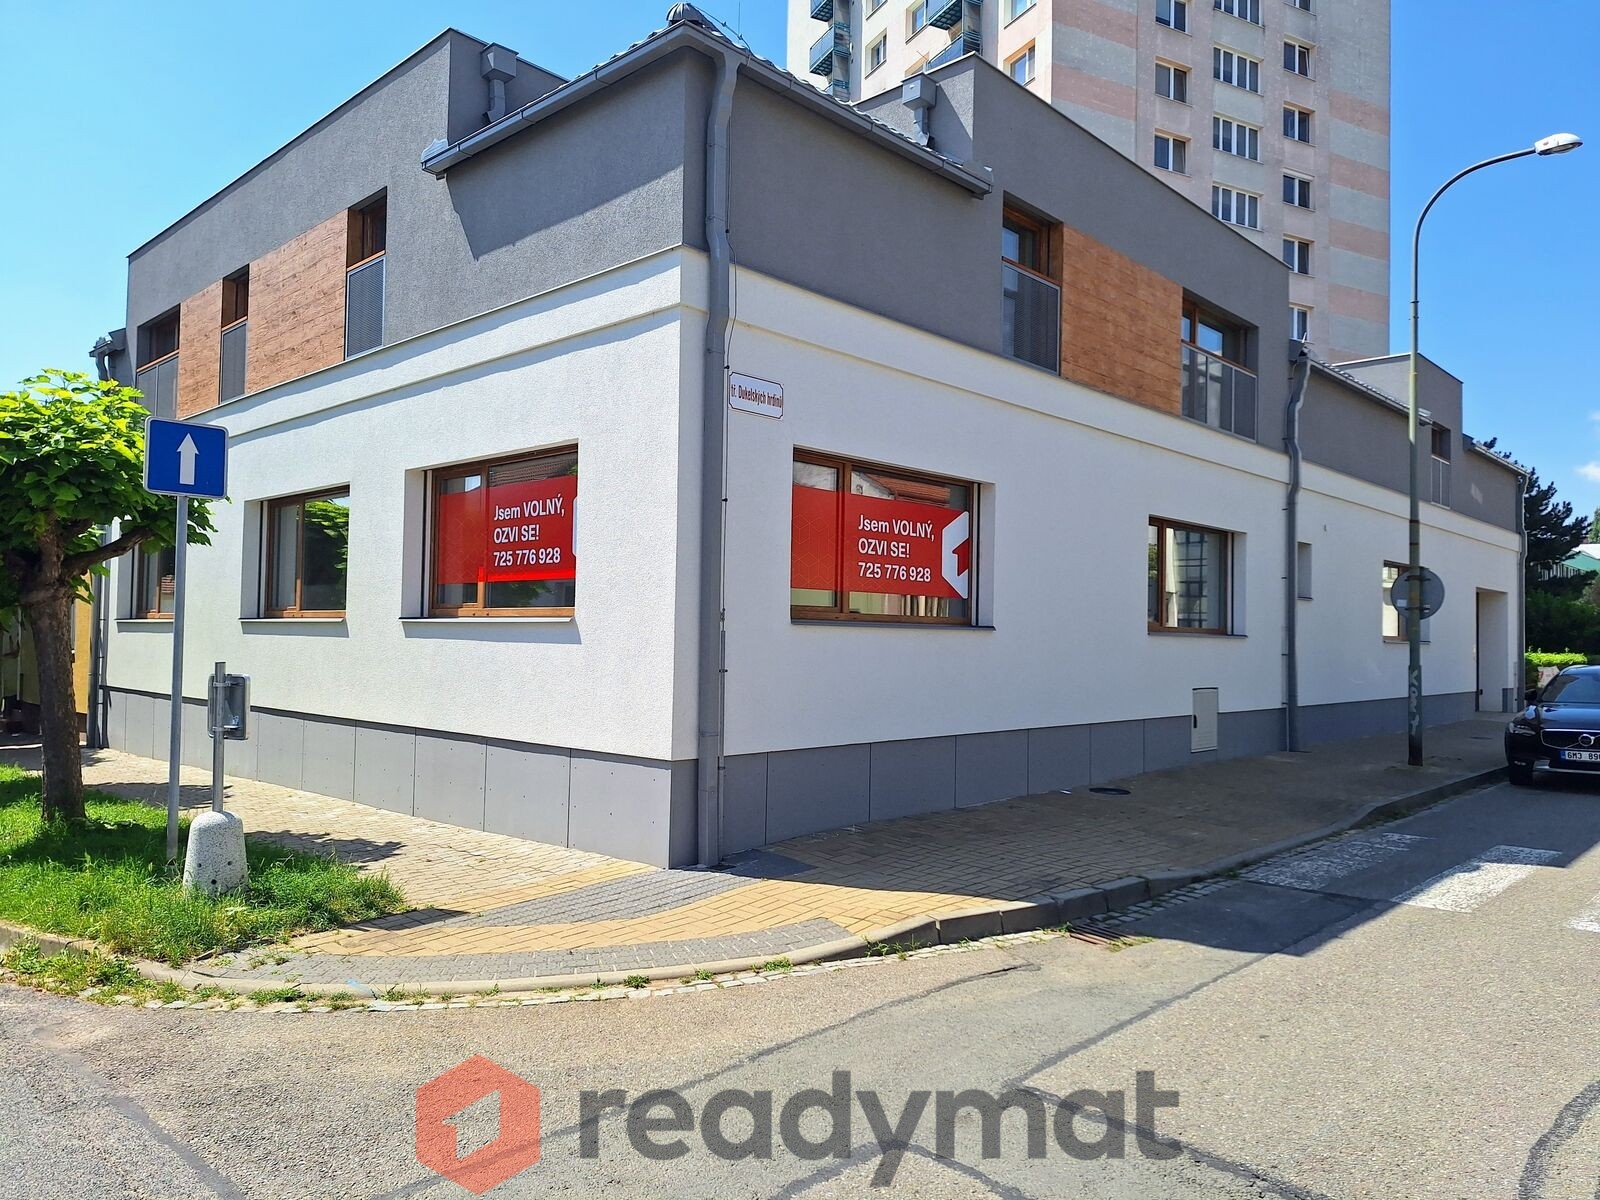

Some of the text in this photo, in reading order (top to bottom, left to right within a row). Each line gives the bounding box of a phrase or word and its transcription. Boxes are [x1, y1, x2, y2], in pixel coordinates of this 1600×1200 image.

[493, 494, 565, 521] Jsem VOLNÝ,
[493, 524, 540, 544] OZVI SE!
[858, 515, 935, 542] Jsem VOLNÝ,
[493, 547, 561, 567] 725 776 928
[858, 537, 910, 558] OZVI SE!
[858, 562, 931, 582] 725 776 928
[1588, 752, 1600, 761] 89
